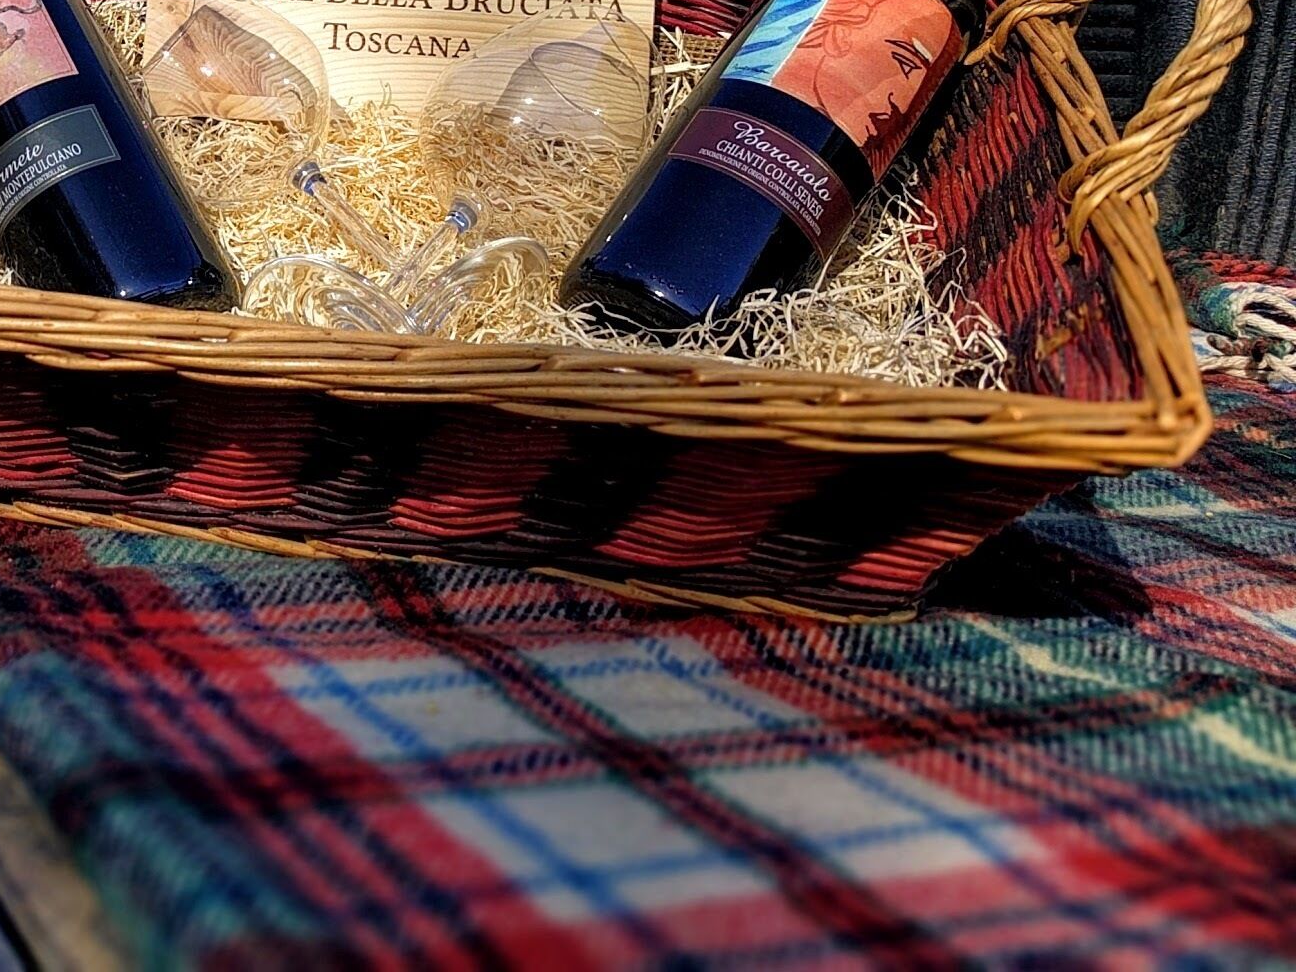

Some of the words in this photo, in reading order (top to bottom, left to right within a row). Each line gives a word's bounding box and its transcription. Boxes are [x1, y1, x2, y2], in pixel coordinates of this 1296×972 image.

[323, 22, 472, 59] TOSCANA
[3, 143, 82, 203] MONTEPULCIANO
[716, 139, 766, 171] CHIANTI
[764, 163, 798, 192] COLLI
[794, 185, 824, 220] SENESI
[733, 121, 832, 202] Barcaiolo
[747, 167, 770, 185] ORIGINE
[768, 181, 801, 211] CONTROLLATA
